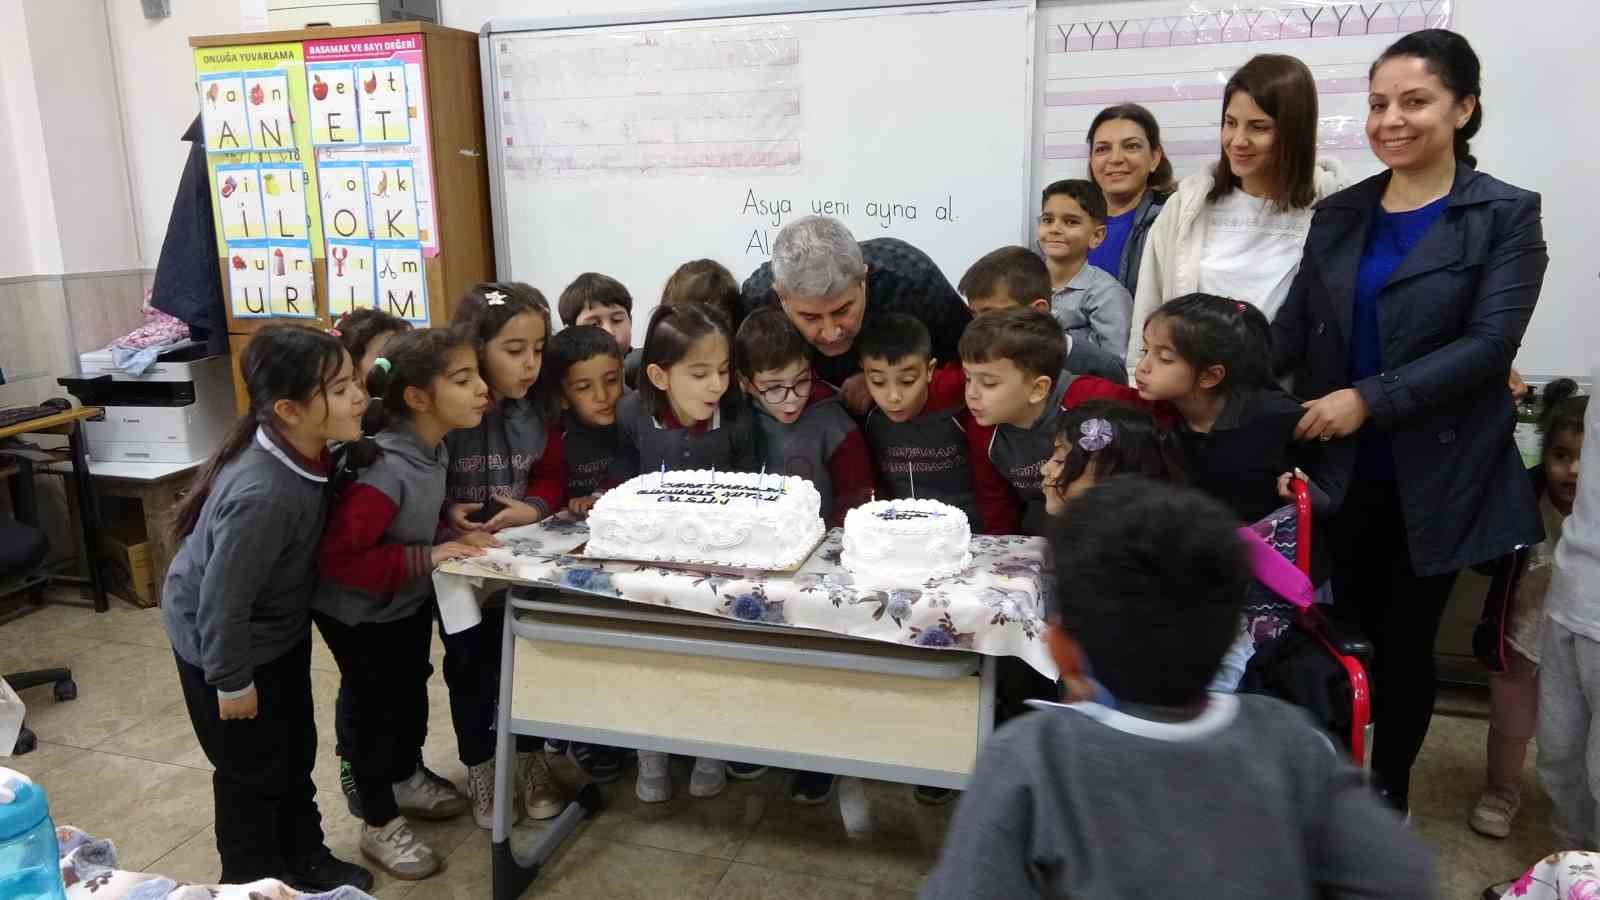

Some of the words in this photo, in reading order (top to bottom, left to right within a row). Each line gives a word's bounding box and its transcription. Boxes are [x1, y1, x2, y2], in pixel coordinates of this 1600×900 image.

[1057, 24, 1075, 52] Y
[1084, 21, 1103, 51] Y
[1109, 20, 1128, 49] Y
[1302, 7, 1324, 38] Y
[1332, 5, 1353, 37] Y
[1360, 3, 1383, 35] Y
[203, 51, 238, 64] ONLUĞA
[239, 50, 295, 62] YUVARLAMA
[309, 44, 350, 55] BASAMAK
[351, 44, 363, 53] VE
[363, 42, 383, 52] SAYI
[384, 37, 416, 50] DEĞERİ
[272, 88, 281, 100] n
[336, 82, 345, 94] e
[387, 71, 397, 92] t
[219, 120, 240, 149] A
[260, 119, 282, 148] N
[328, 112, 345, 142] E
[375, 110, 391, 140] T
[347, 179, 356, 192] o
[396, 169, 406, 191] k
[742, 187, 792, 227] Asya
[811, 200, 850, 217] yeni
[865, 202, 918, 229] ayna
[935, 194, 960, 223] al.
[278, 209, 295, 238] L
[334, 208, 357, 237] O
[386, 209, 406, 238] K
[295, 258, 303, 270] r
[402, 260, 417, 273] m
[244, 287, 264, 314] U
[286, 286, 300, 313] R
[387, 289, 416, 318] M
